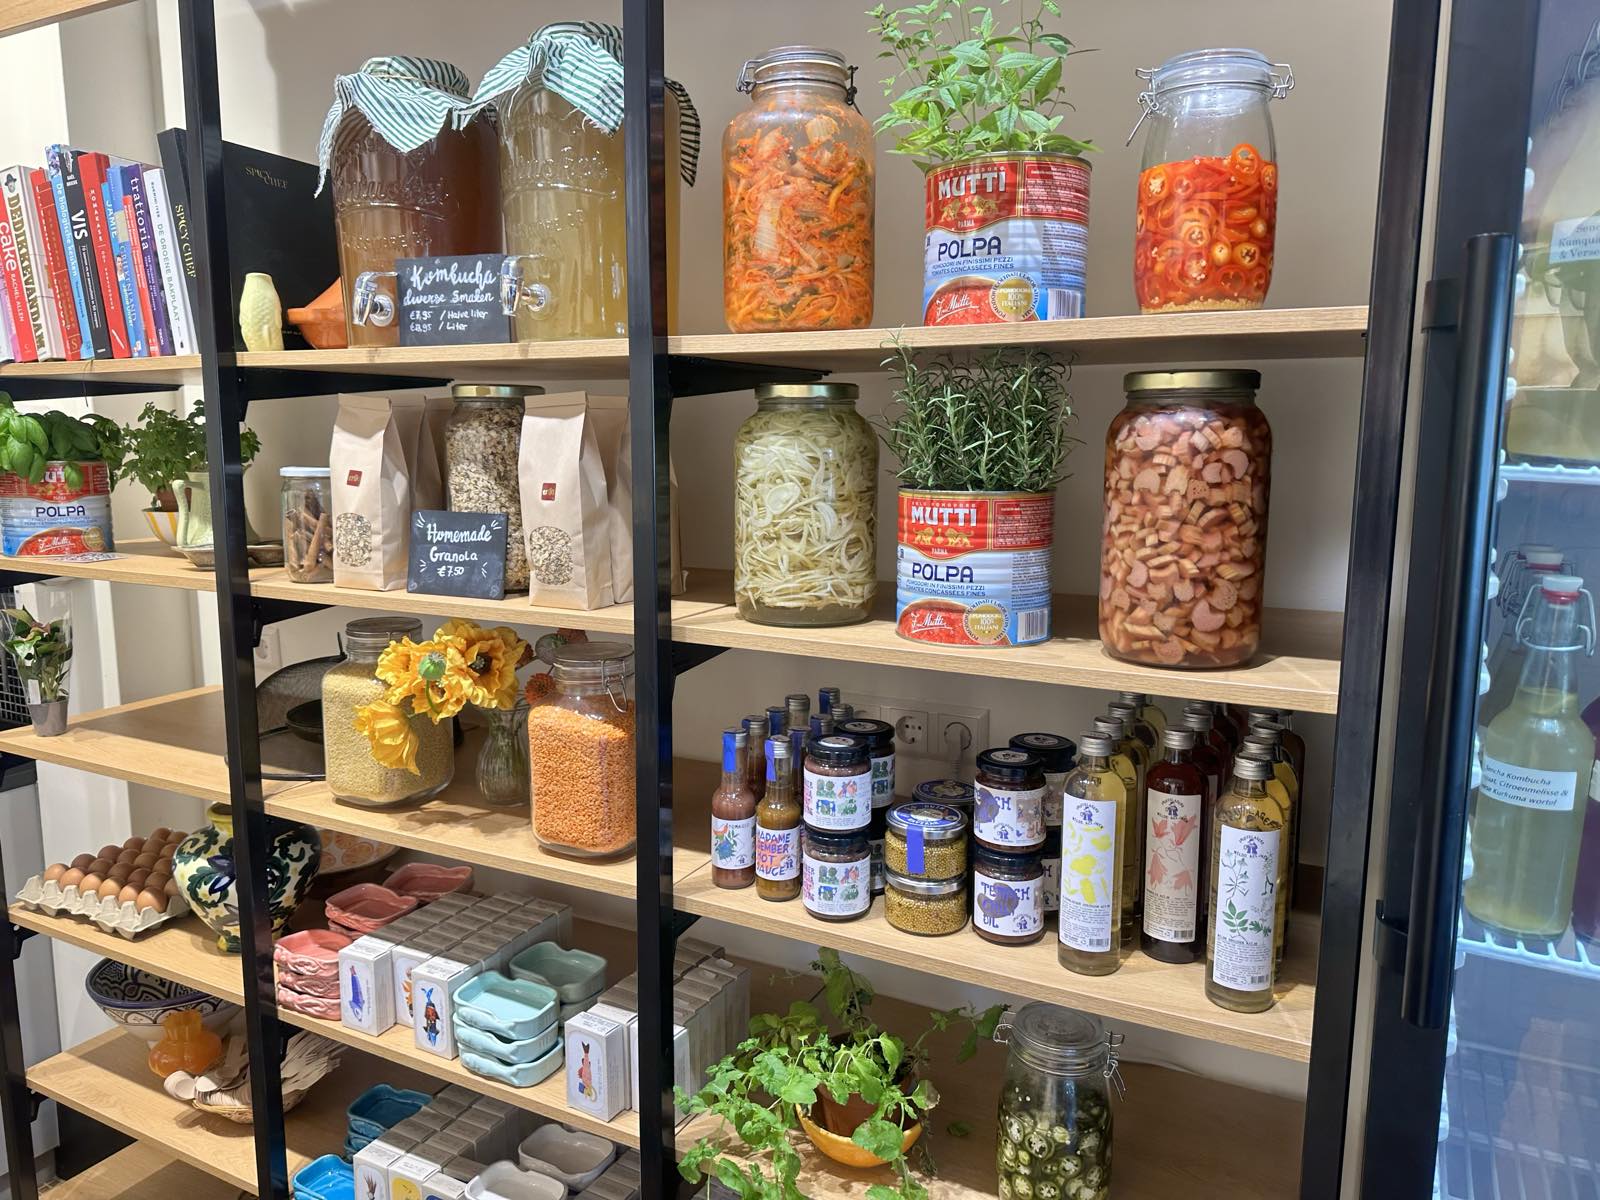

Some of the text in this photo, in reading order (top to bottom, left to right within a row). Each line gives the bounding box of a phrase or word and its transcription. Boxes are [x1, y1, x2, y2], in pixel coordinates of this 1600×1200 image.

[938, 171, 1006, 201] MUTTI
[71, 209, 88, 240] VIS
[106, 200, 118, 238] JAMIE
[130, 177, 150, 250] trattoria
[175, 204, 196, 278] SPICY CHEF
[938, 236, 1002, 261] POLPA
[0, 222, 17, 271] cake
[10, 273, 20, 300] RACHEL
[16, 301, 25, 322] ALLEN
[157, 223, 180, 322] DE GROENE BAKPLAAT
[410, 260, 497, 291] Kombucha
[35, 505, 86, 518] POLPA
[911, 505, 977, 527] MUTTI
[426, 522, 493, 543] Homemade
[912, 562, 974, 583] POLPA
[1498, 780, 1559, 797] Citroenmelisse
[1506, 772, 1551, 786] Kombucha
[1492, 787, 1527, 803] Kurkuma
[1529, 798, 1558, 807] wortel
